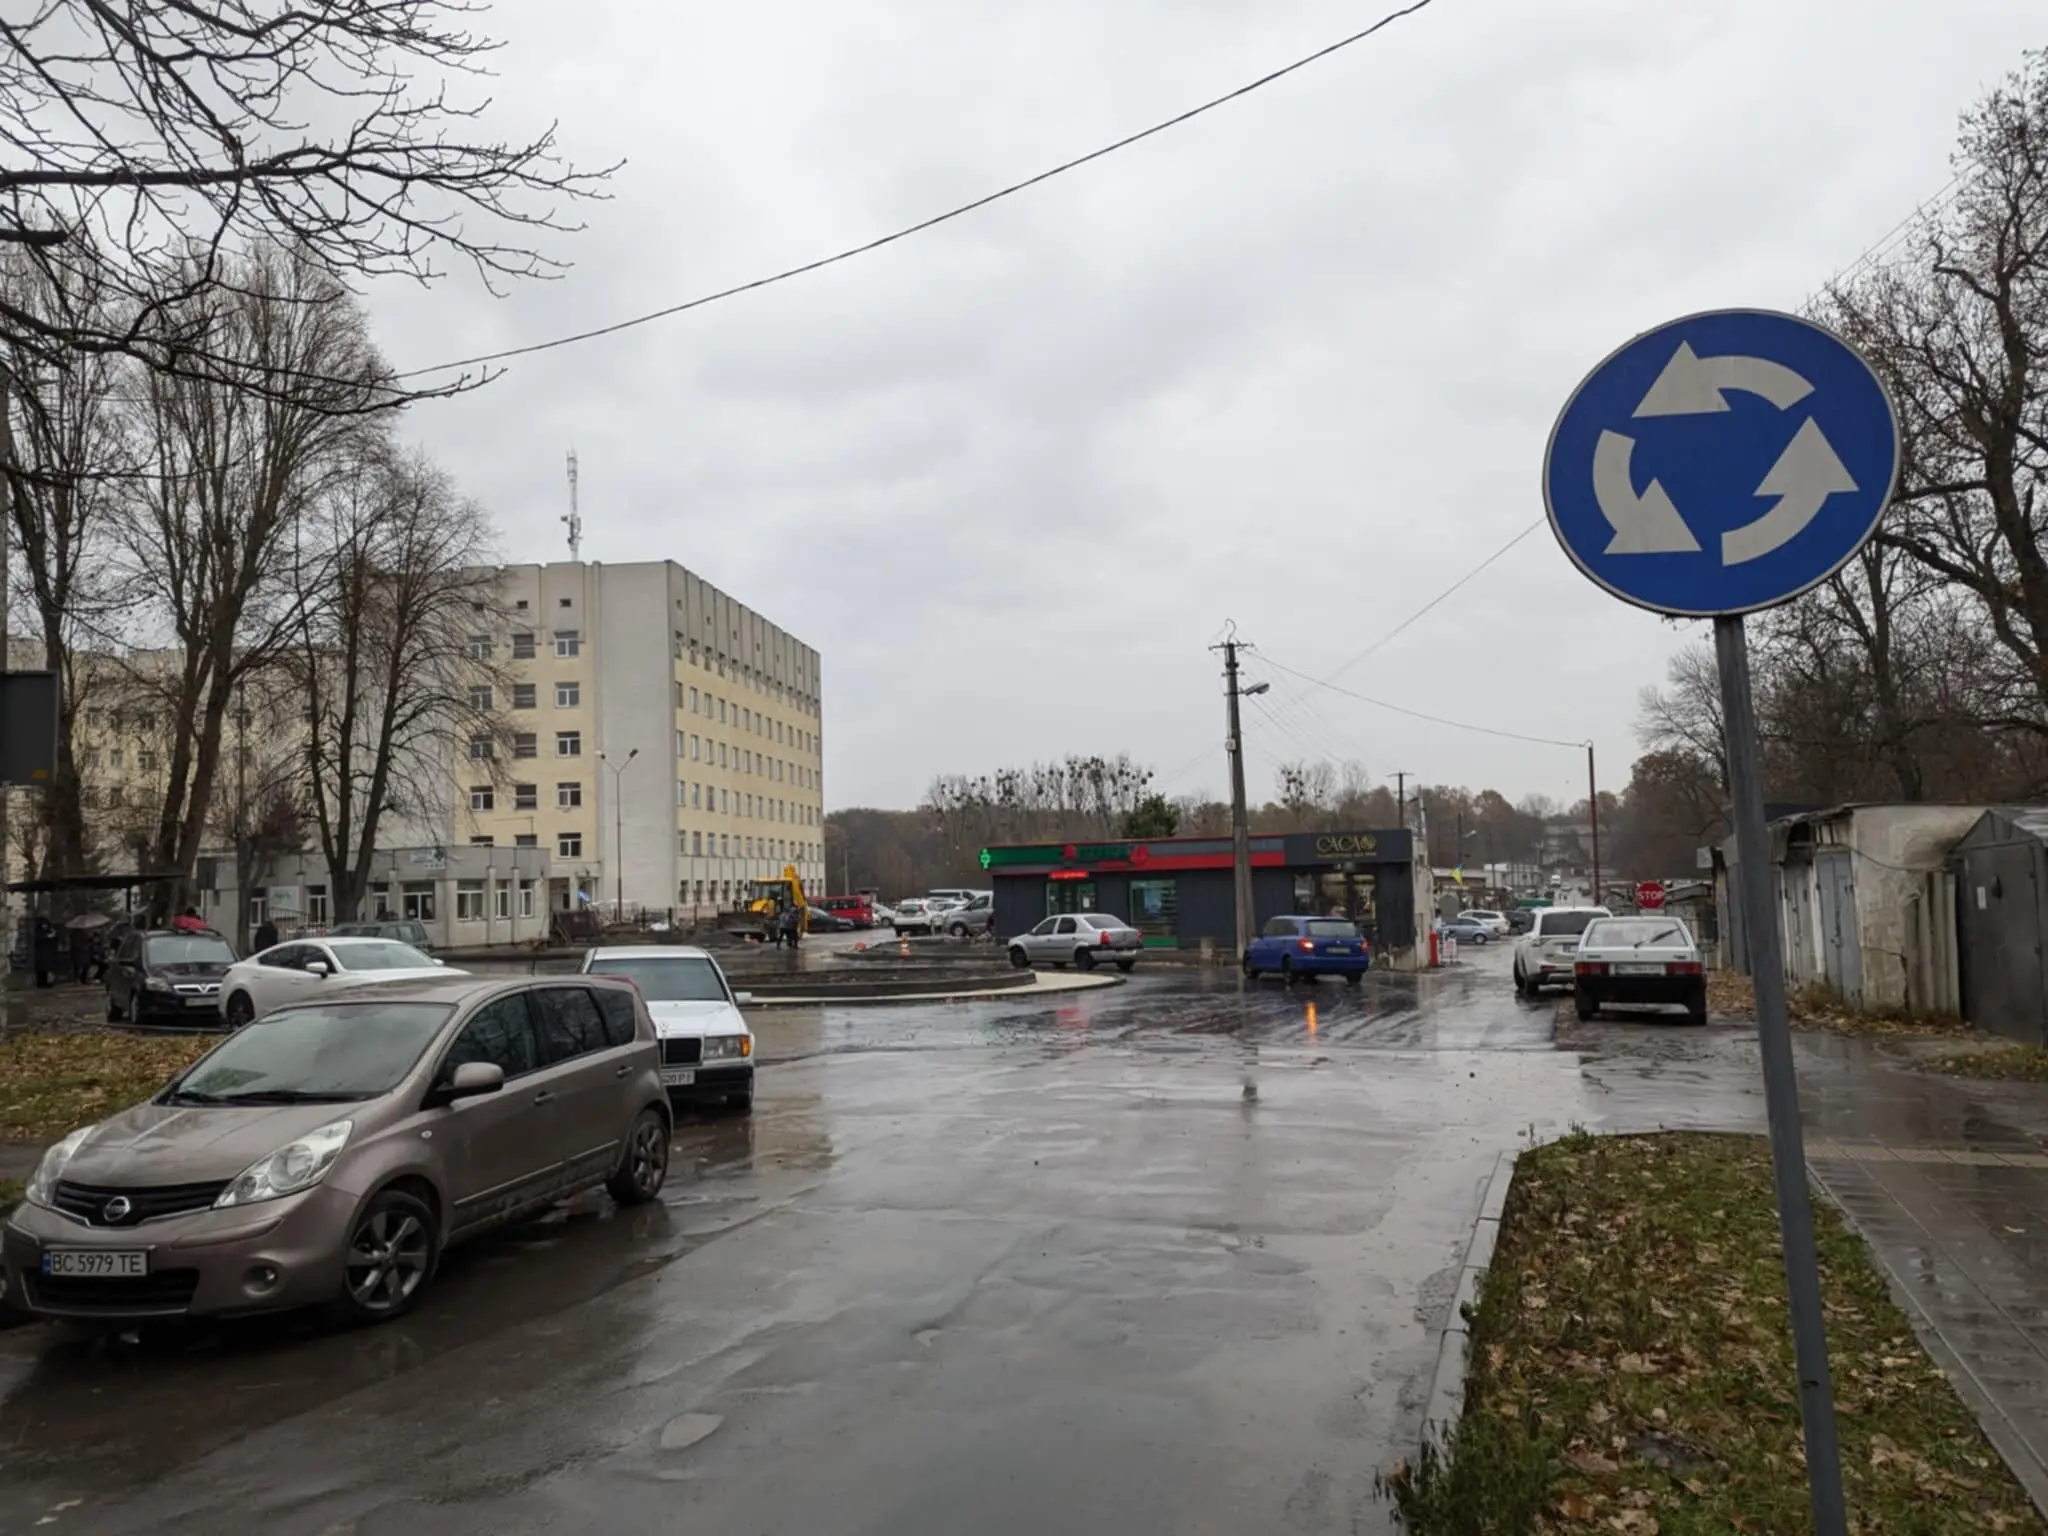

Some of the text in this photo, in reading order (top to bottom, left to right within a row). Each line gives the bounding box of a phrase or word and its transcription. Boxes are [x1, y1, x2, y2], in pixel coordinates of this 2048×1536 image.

[1637, 891, 1664, 901] STOP
[52, 1254, 142, 1273] BC 5979 TE
